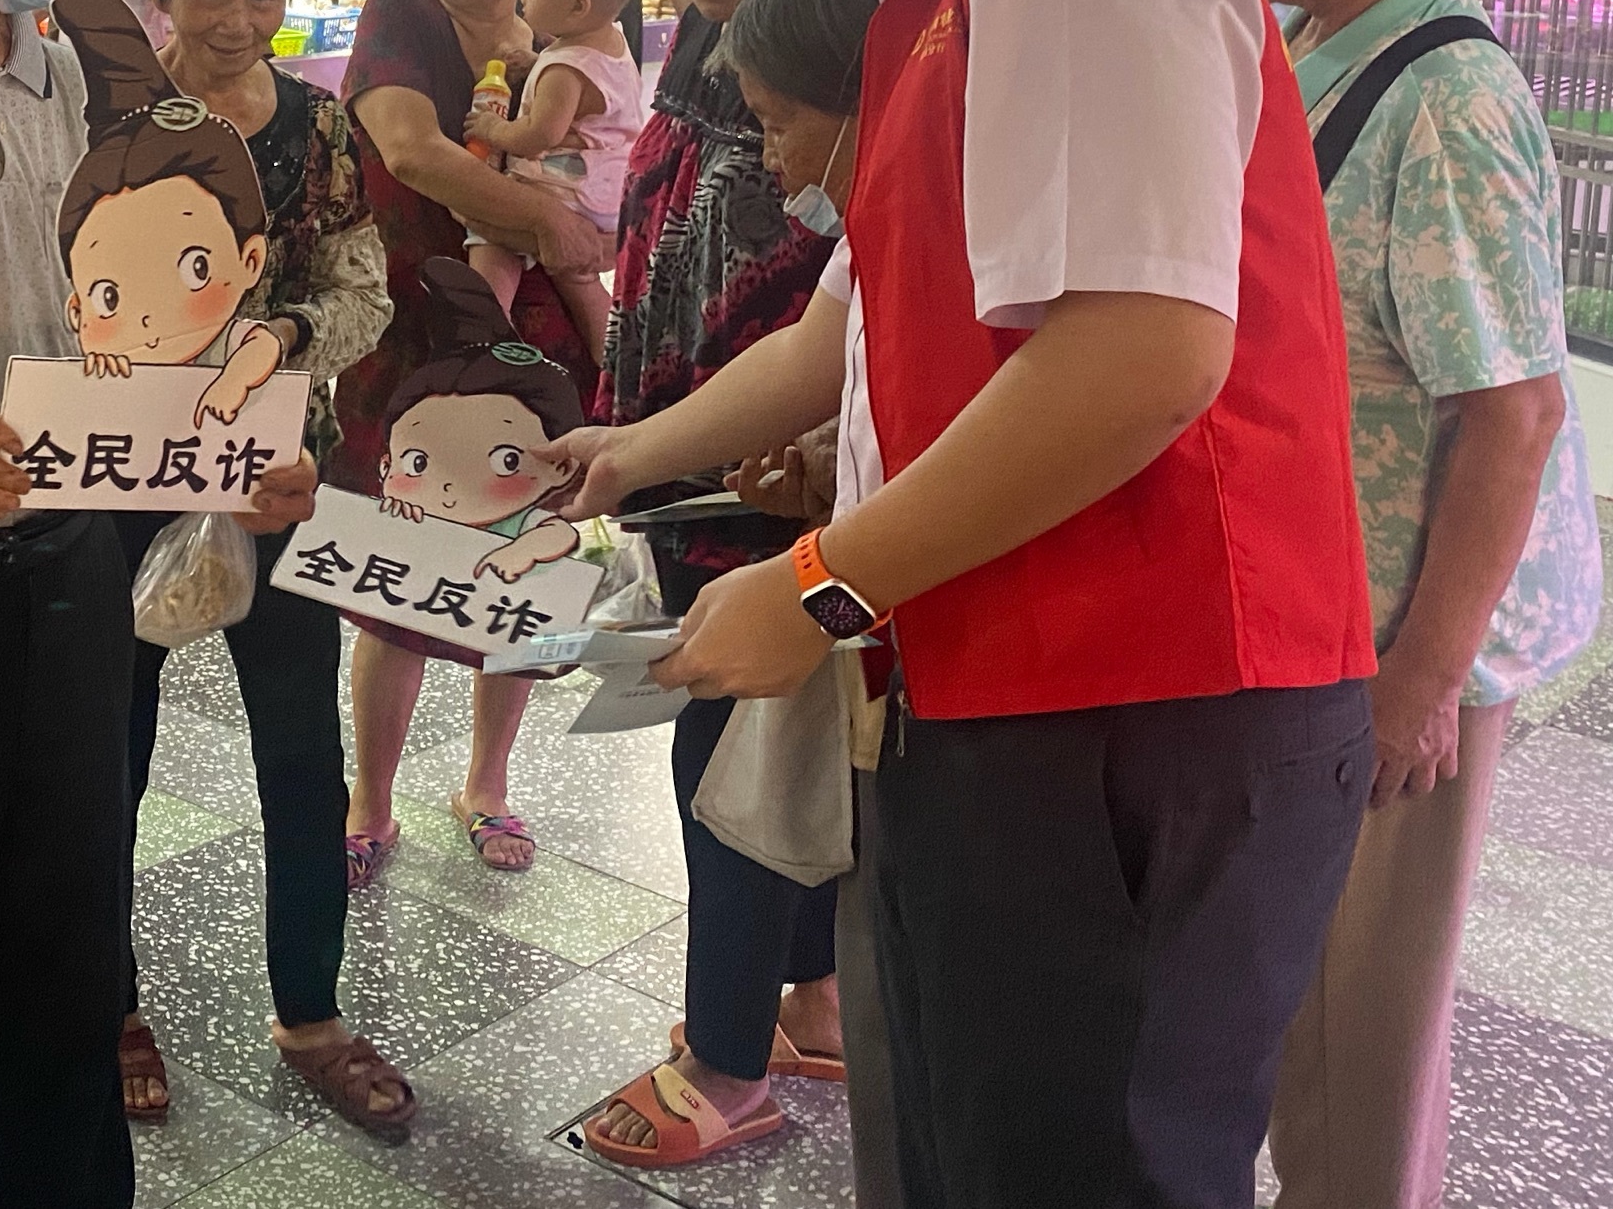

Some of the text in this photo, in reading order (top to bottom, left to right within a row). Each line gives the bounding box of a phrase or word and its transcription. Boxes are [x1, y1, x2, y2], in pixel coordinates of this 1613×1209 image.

[11, 429, 277, 496] 全民反诈
[295, 540, 555, 646] 全民反诈
